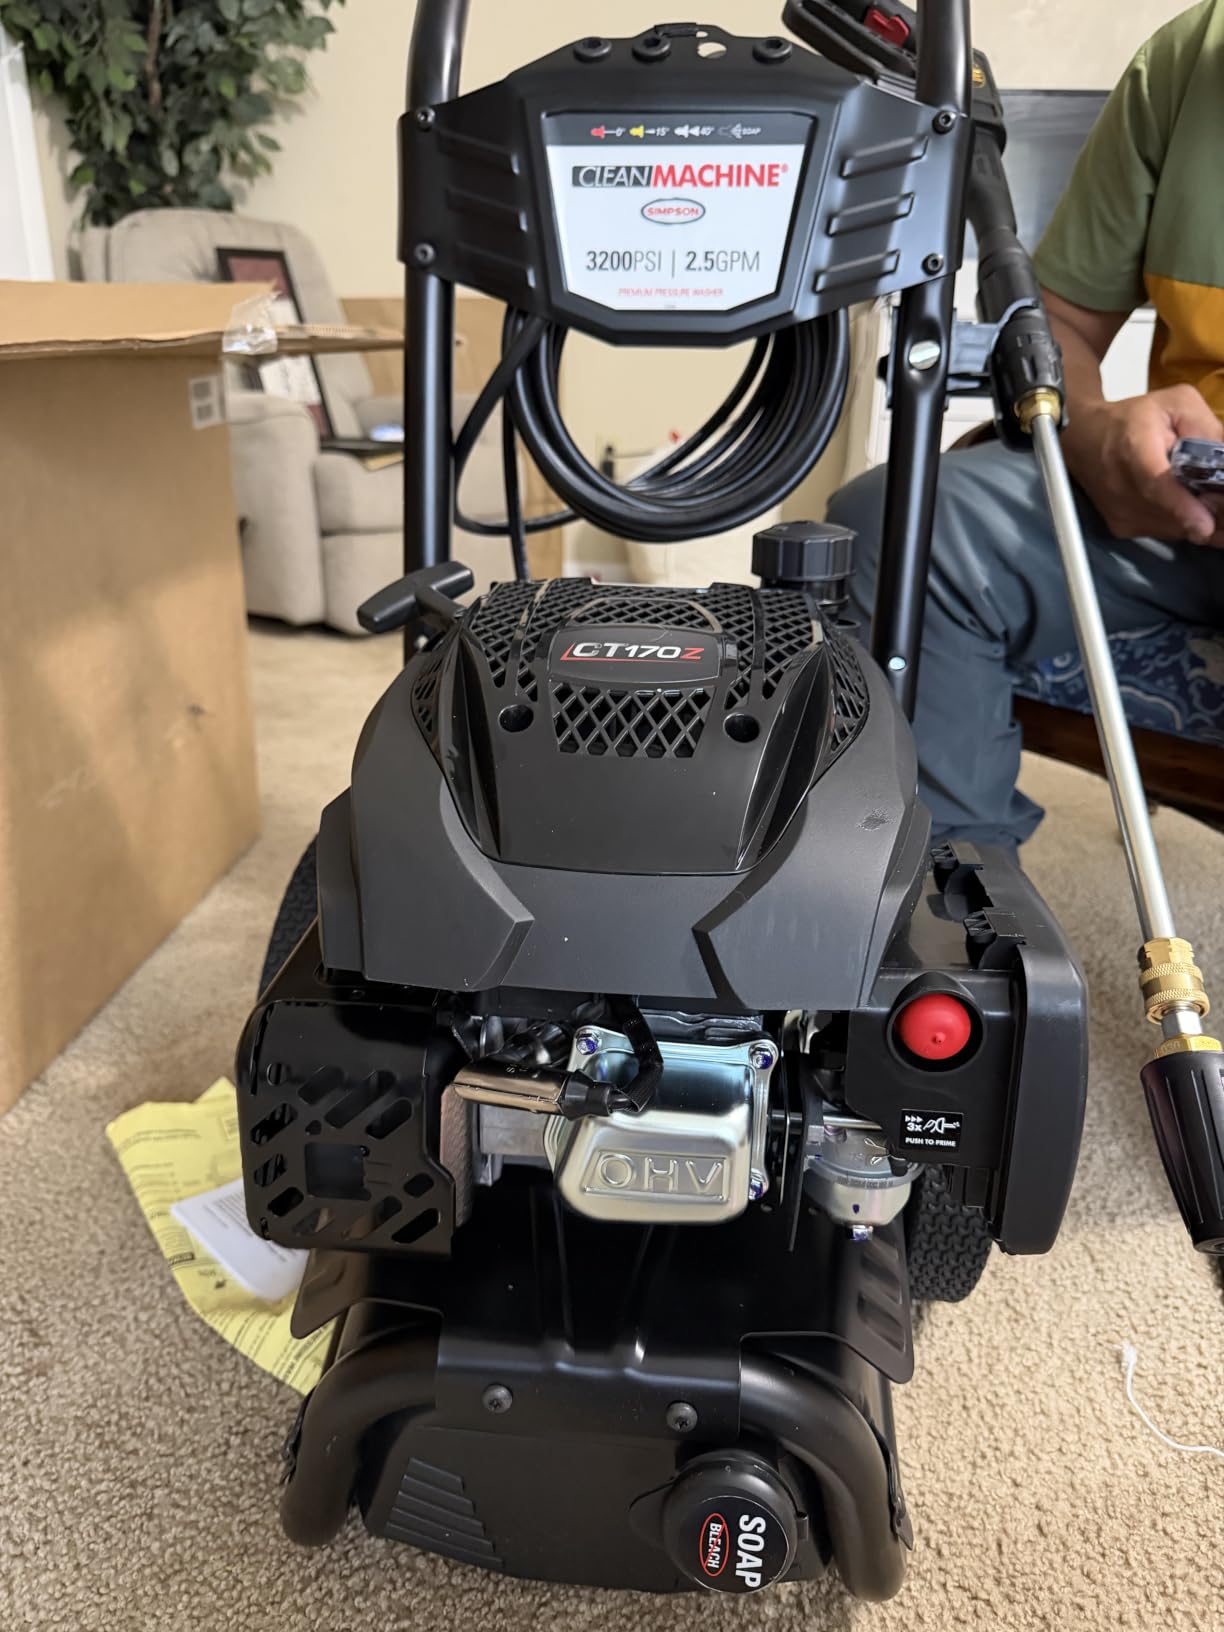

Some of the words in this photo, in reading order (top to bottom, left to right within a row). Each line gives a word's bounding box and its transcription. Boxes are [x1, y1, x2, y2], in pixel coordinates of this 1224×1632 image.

[646, 207, 700, 217] SIMPSON
[586, 250, 662, 272] 3200PSI
[685, 250, 761, 272] 2.5GPM
[618, 287, 653, 297] PREMIUM
[655, 287, 690, 297] PRESSURE
[692, 287, 723, 297] WASHER
[906, 1122, 923, 1132] 3x
[905, 1137, 924, 1145] PUSH
[925, 1138, 935, 1146] TO
[935, 1139, 956, 1147] PRIME
[598, 1152, 724, 1193] OHV
[707, 1522, 722, 1569] BLEACH
[735, 1514, 766, 1588] SOAP
